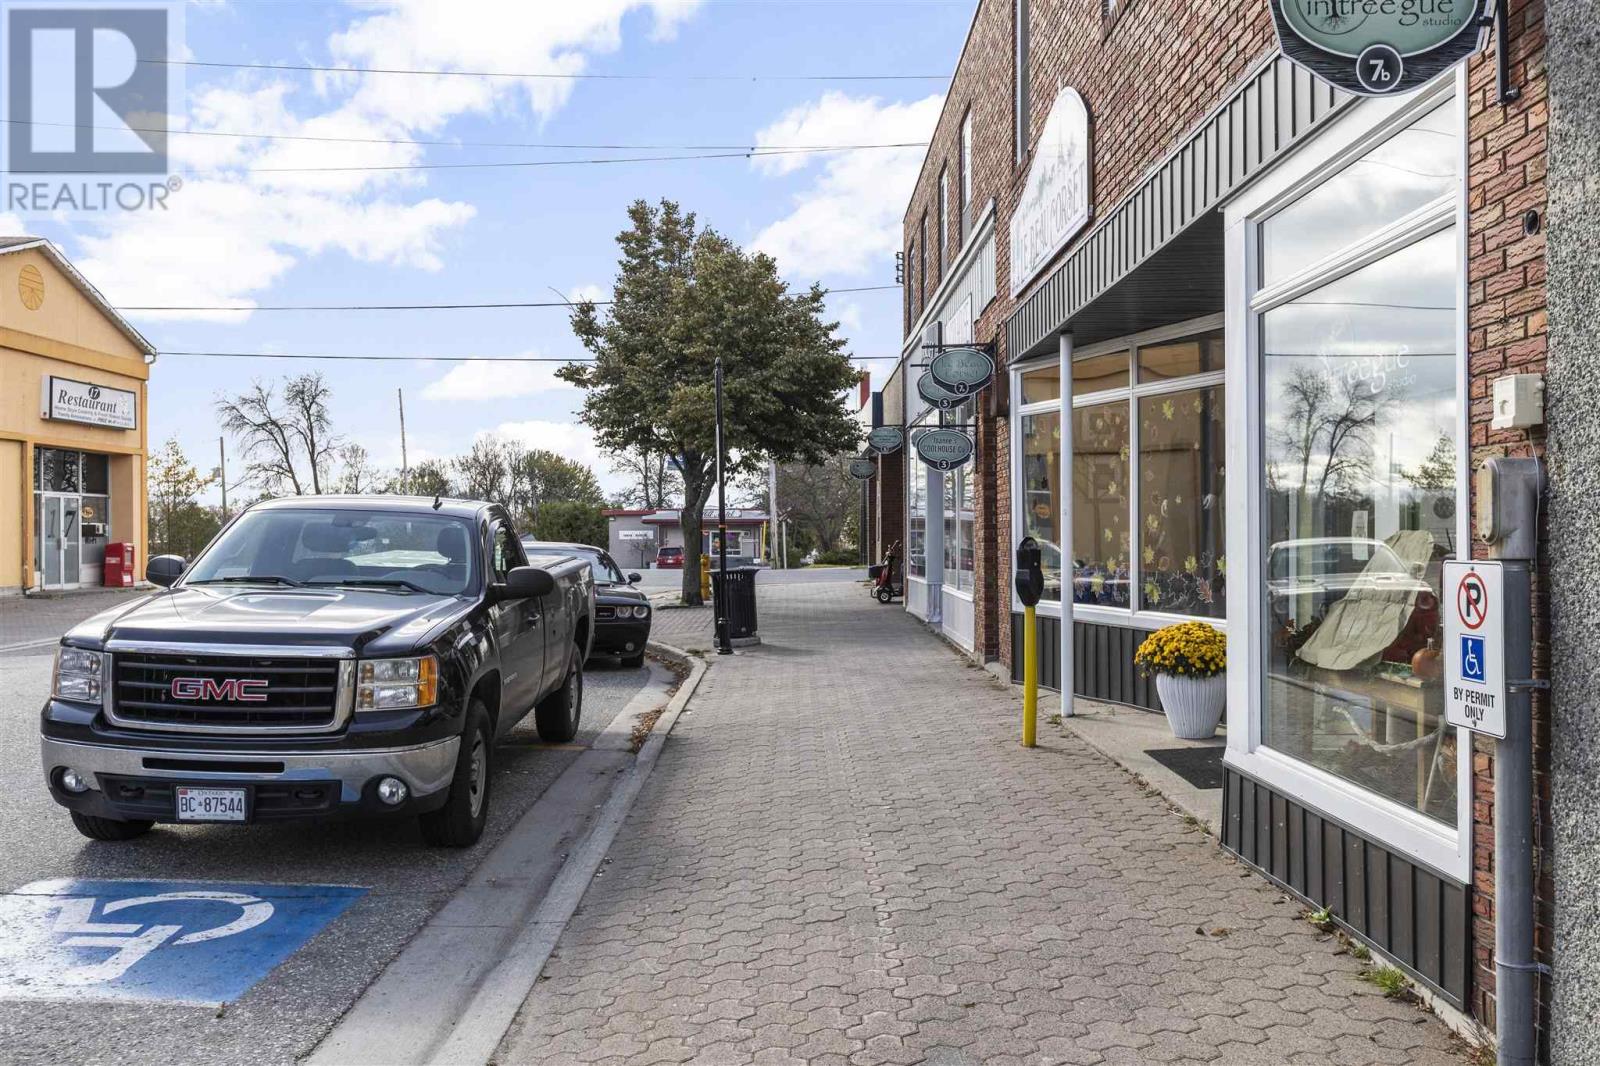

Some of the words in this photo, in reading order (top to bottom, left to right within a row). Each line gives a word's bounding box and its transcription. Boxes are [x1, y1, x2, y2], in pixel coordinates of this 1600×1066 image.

[1422, 15, 1462, 26] studio
[1368, 59, 1391, 82] 7b
[57, 389, 117, 414] Restaurant
[941, 460, 947, 468] 3
[171, 677, 269, 701] GMC
[1453, 686, 1463, 700] BY
[1465, 688, 1495, 708] PERMIT
[1464, 704, 1484, 722] ONLY
